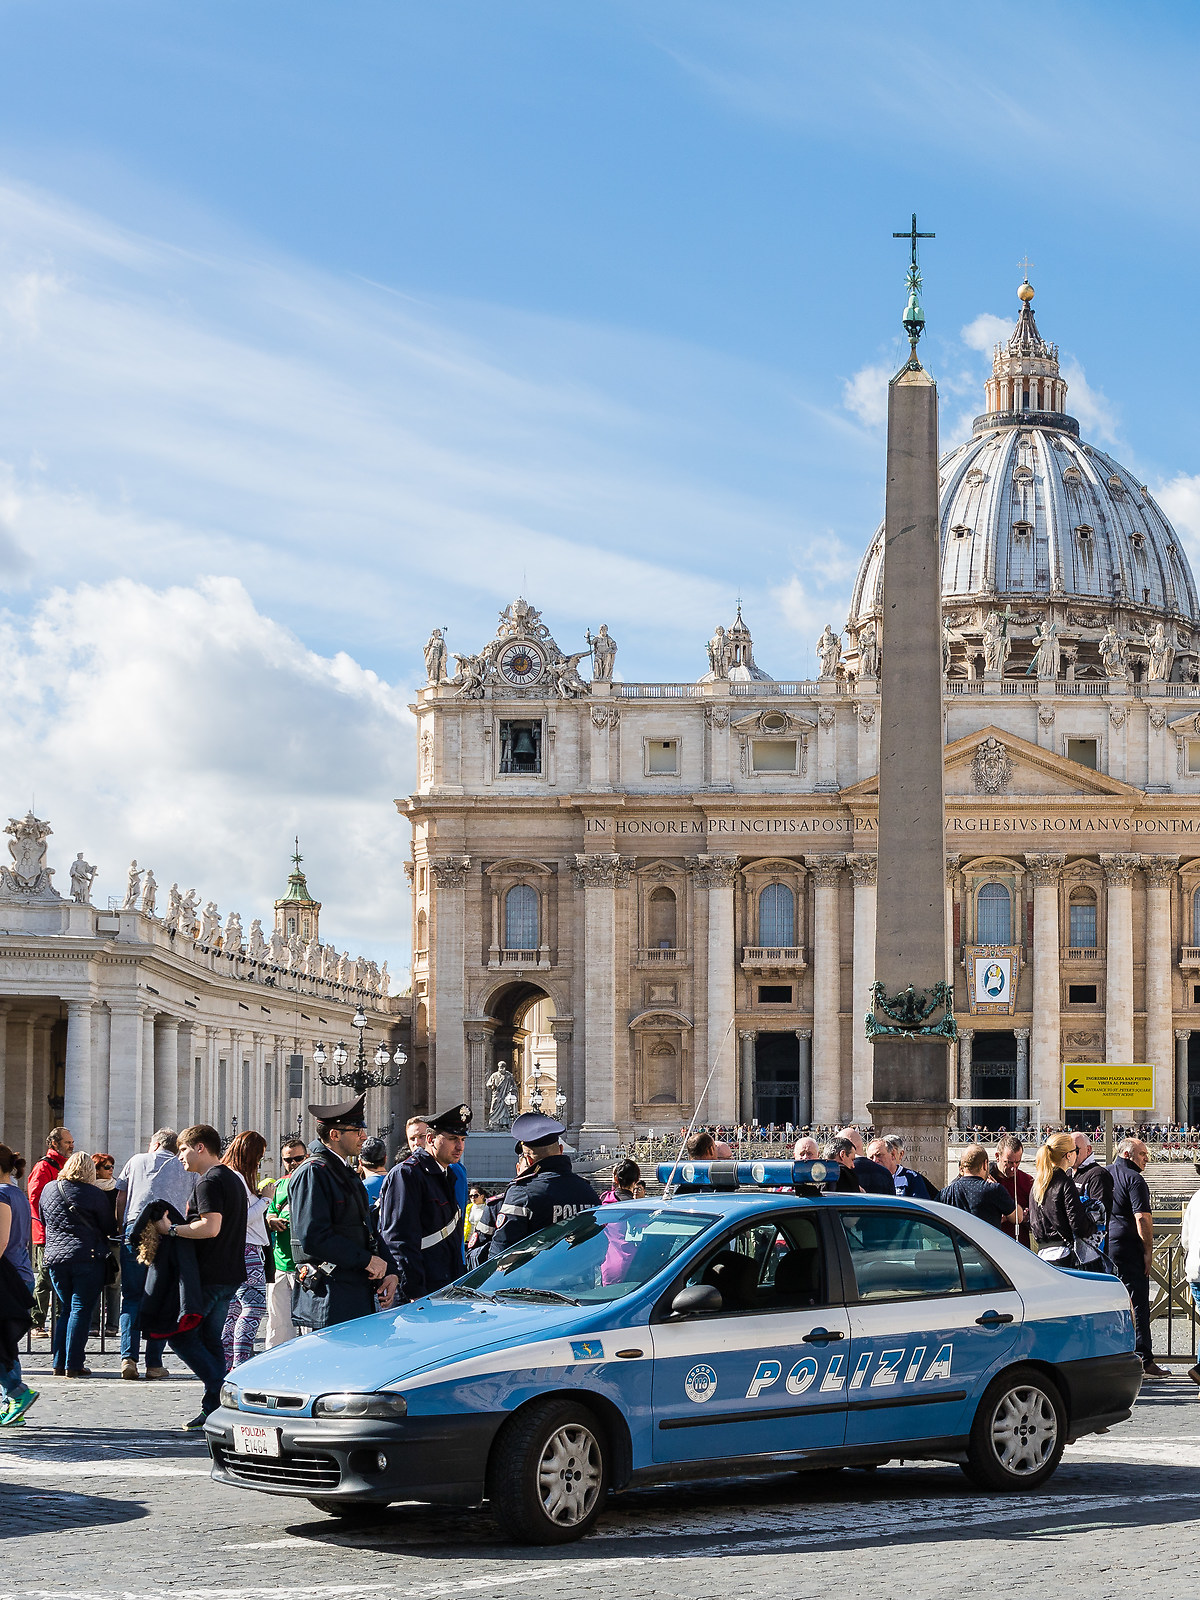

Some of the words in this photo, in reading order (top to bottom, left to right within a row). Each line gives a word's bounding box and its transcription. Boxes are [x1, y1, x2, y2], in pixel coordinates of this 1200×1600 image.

[586, 819, 606, 832] IN
[616, 820, 704, 834] HONOREM
[709, 819, 796, 832] PRINCIPIS
[799, 819, 853, 832] APOST
[1042, 818, 1130, 831] ROMANVS
[745, 1343, 954, 1398] POLIZIA
[240, 1426, 267, 1437] POLIZIA
